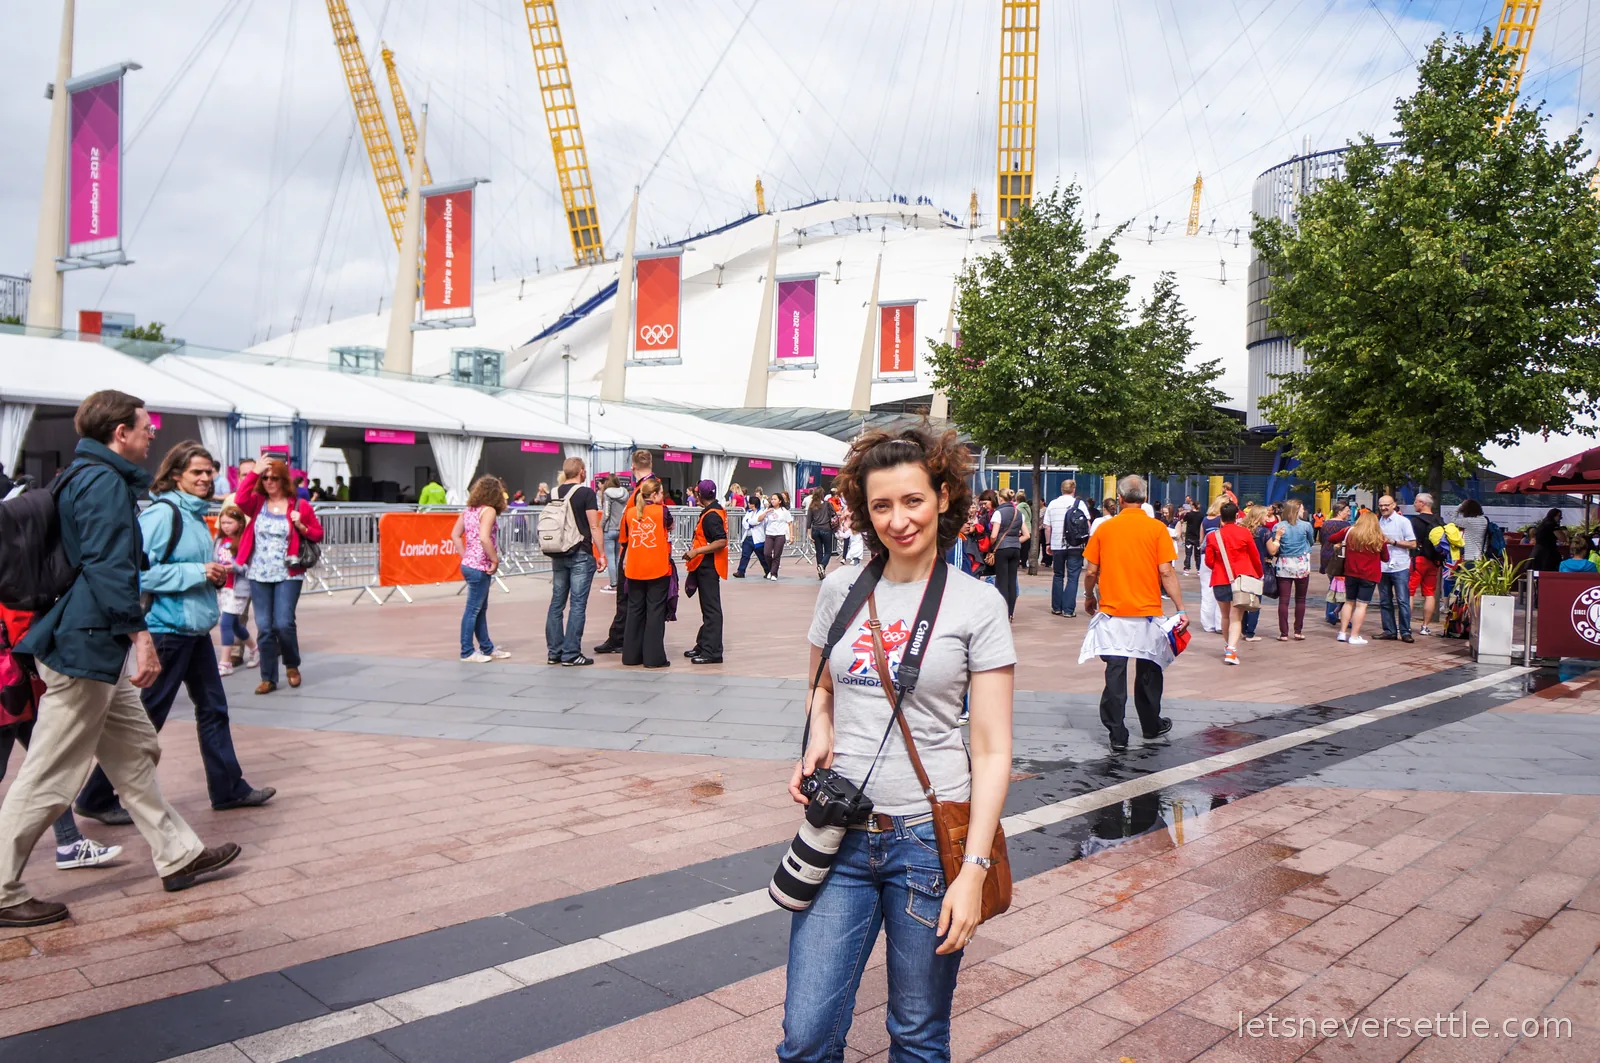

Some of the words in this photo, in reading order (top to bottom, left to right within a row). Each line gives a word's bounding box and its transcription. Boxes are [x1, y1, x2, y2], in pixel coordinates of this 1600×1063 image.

[90, 147, 99, 179] 2012
[89, 182, 99, 235] London
[444, 199, 454, 258] generation
[445, 259, 452, 268] a
[443, 269, 453, 304] Inspire
[893, 309, 901, 343] generation
[400, 539, 438, 556] London
[440, 539, 459, 555] 201
[1581, 589, 1600, 605] CO
[910, 620, 929, 655] Canon
